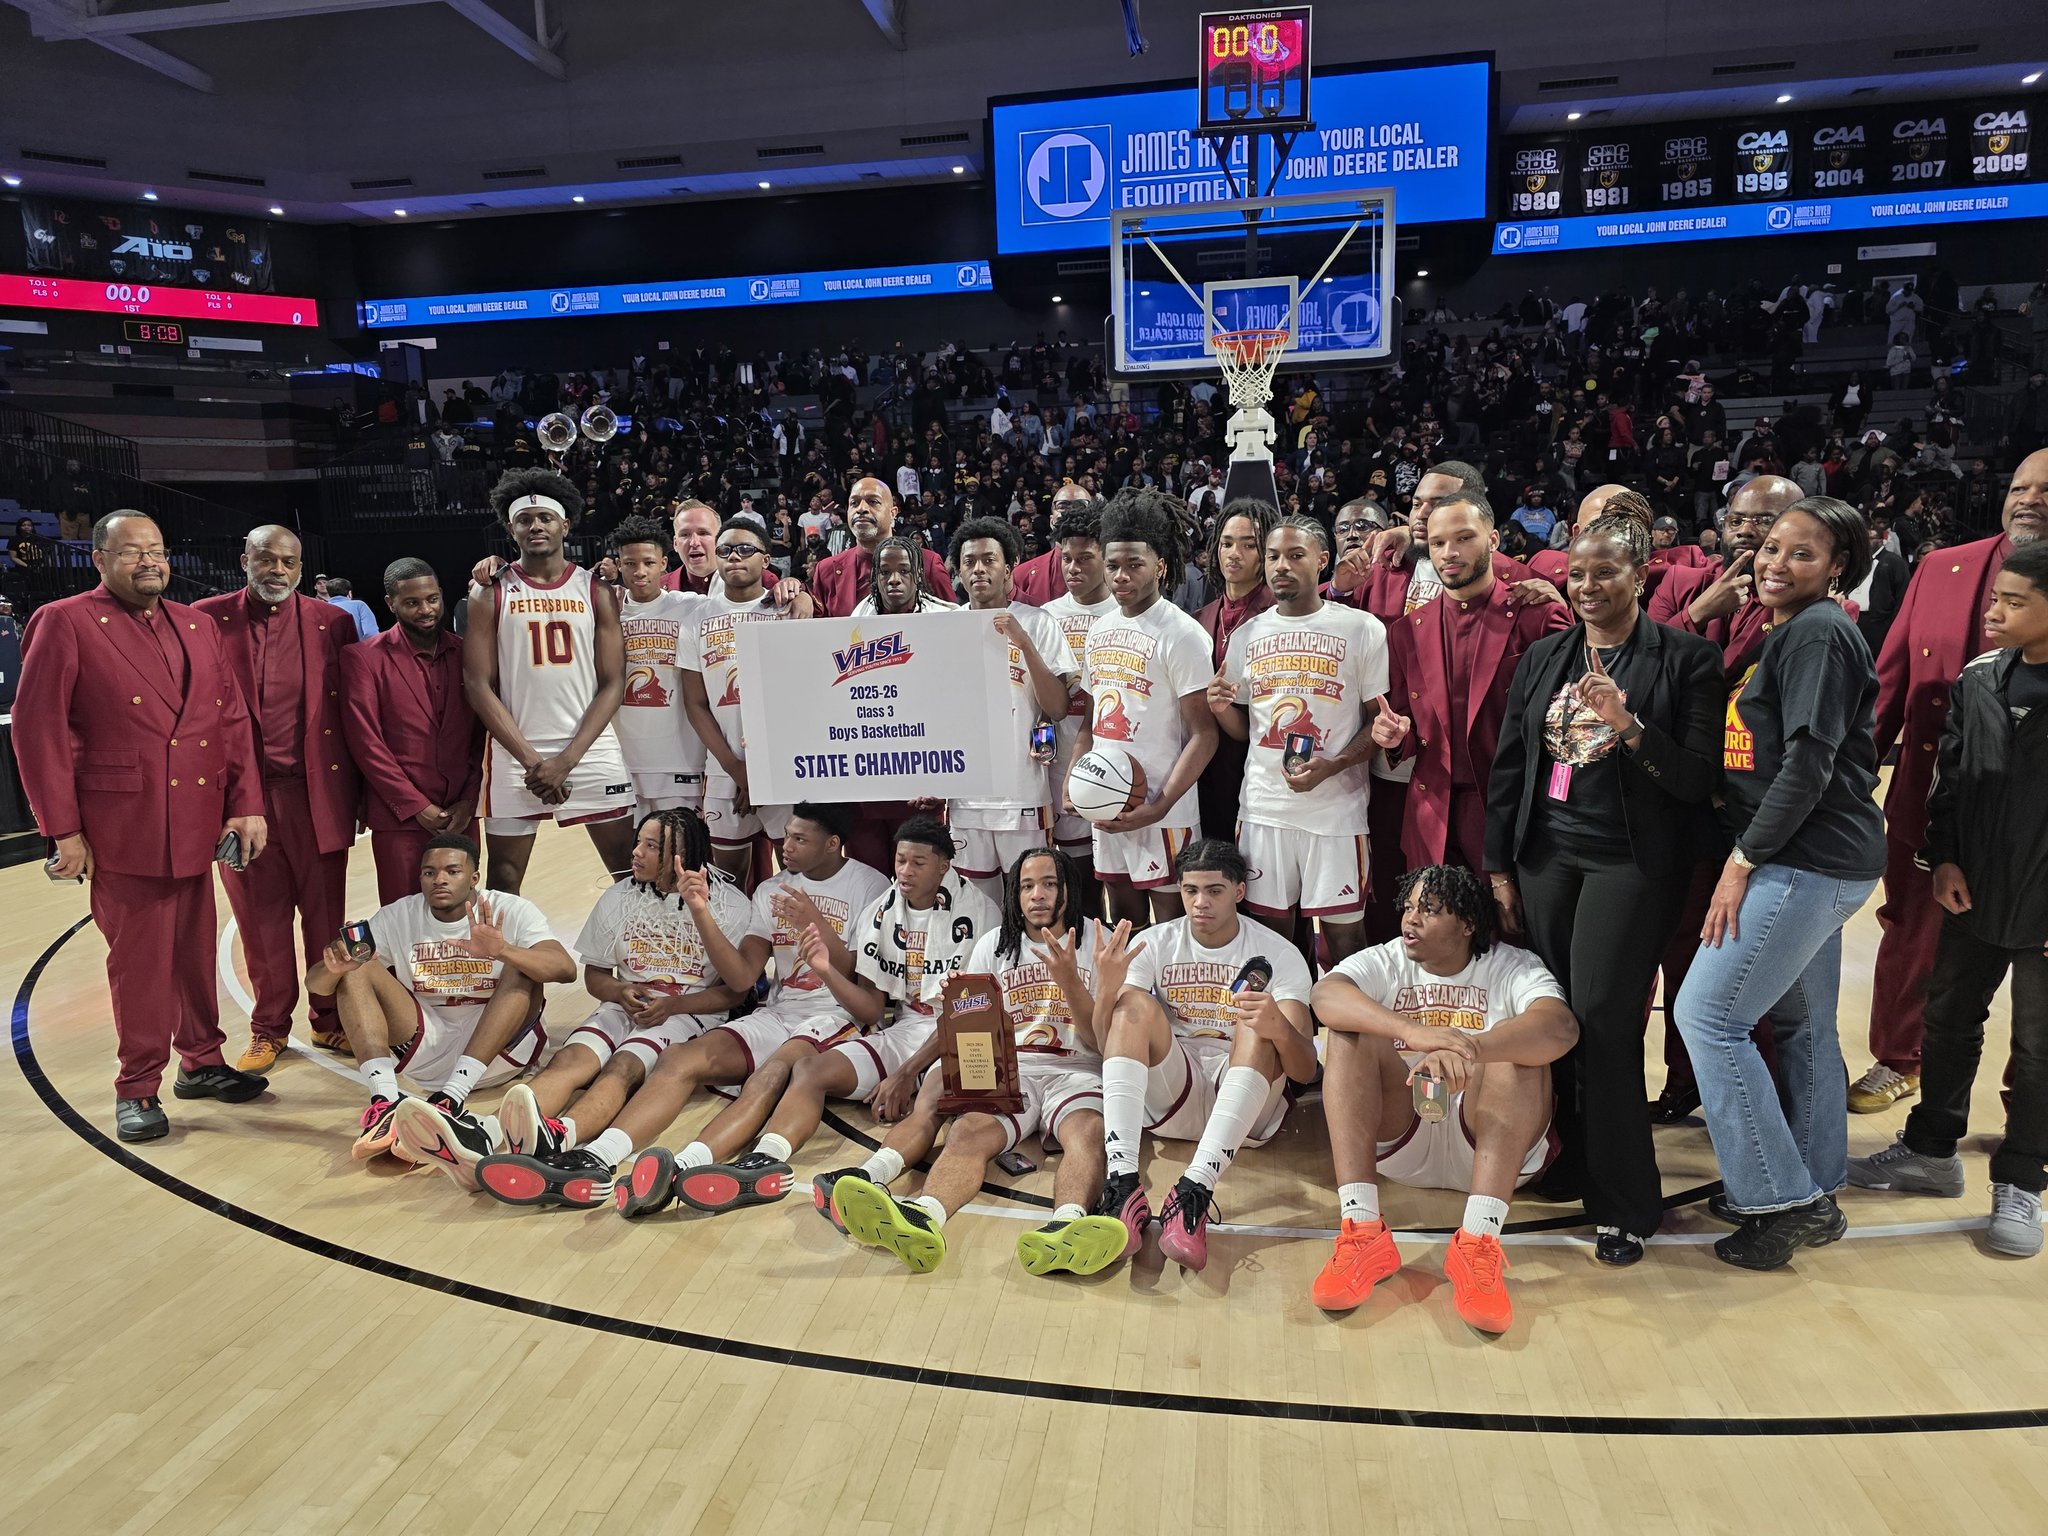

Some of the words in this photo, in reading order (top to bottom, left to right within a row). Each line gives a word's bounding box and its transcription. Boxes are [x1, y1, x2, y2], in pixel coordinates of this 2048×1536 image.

[1228, 11, 1282, 21] DAKTRONICS
[1892, 117, 1946, 138] CAA
[1973, 110, 2027, 130] CAA
[1320, 127, 1364, 151] YOUR
[1370, 122, 1424, 148] LOCAL
[1737, 129, 1789, 150] CAA
[1813, 125, 1865, 145] CAA
[1121, 129, 1191, 174] JAMES
[1588, 143, 1629, 167] SBC
[1665, 136, 1707, 160] SBC
[1285, 156, 1328, 180] JOHN
[1333, 151, 1388, 177] DEERE
[1393, 145, 1458, 172] DEALER
[1516, 148, 1556, 171] SBC
[1972, 153, 2028, 174] 2009
[1814, 168, 1864, 188] 2004
[1892, 160, 1946, 181] 2007
[1662, 177, 1712, 201] 1985
[1736, 171, 1788, 193] 1996
[1512, 191, 1560, 212] 1980
[1585, 186, 1629, 207] 1981
[1871, 205, 1894, 217] YOUR
[1895, 203, 1922, 216] LOCAL
[1923, 201, 1946, 213] JOHN
[1947, 199, 1975, 212] DEERE
[1975, 197, 2009, 210] DEALER
[1597, 225, 1618, 237] YOUR
[1619, 223, 1645, 235] LOCAL
[1646, 220, 1667, 233] JOHN
[1668, 219, 1694, 231] DEERE
[1695, 216, 1727, 229] DEALER
[823, 280, 842, 291] YOUR
[842, 279, 864, 289] LOCAL
[865, 277, 882, 288] JOHN
[883, 276, 905, 287] DEERE
[905, 274, 932, 285] DEALER
[105, 284, 150, 303] 00.0
[622, 293, 640, 303] YOUR
[640, 292, 661, 302] LOCAL
[662, 290, 679, 301] JOHN
[679, 289, 700, 300] DEERE
[700, 287, 726, 298] DEALER
[124, 304, 140, 312] 1ST
[208, 301, 221, 309] FLS
[428, 305, 445, 315] YOUR
[446, 304, 466, 314] LOCAL
[466, 303, 482, 313] JOHN
[483, 302, 503, 312] DEERE
[503, 300, 528, 311] DEALER
[292, 312, 302, 324] 0
[140, 324, 178, 341] 8:08
[510, 599, 585, 614] PETERSBURG
[627, 619, 680, 638] CHAMPIONS
[701, 613, 731, 638] STATE
[527, 619, 573, 667] 10
[832, 631, 910, 674] VHSL
[1088, 630, 1114, 655] STATE
[1114, 628, 1158, 660] CHAMPIONS
[1246, 634, 1278, 664] STATE
[1278, 631, 1346, 661] CHAMPIONS
[708, 655, 717, 664] 20
[1089, 648, 1146, 675] PETERSBURG
[1250, 654, 1338, 678] PETERSBURG
[1010, 669, 1020, 680] 26
[1260, 675, 1298, 689] Crimson
[1297, 672, 1325, 688] Wave
[850, 684, 898, 700] 2025-26
[1136, 679, 1147, 692] 26
[1252, 684, 1262, 696] 20
[1325, 683, 1338, 696] 26
[856, 706, 885, 718] Class
[887, 705, 894, 717] 3
[829, 725, 859, 742] Boys
[861, 723, 925, 739] Basketball
[794, 754, 849, 779] STATE
[854, 750, 966, 776] CHAMPIONS
[774, 935, 785, 944] 20
[411, 942, 440, 963] STATE
[414, 960, 493, 977] PETERSBURG
[1002, 963, 1034, 992] STATE
[1161, 962, 1197, 988] STATE
[425, 975, 462, 989] Crimson
[482, 979, 494, 989] 26
[953, 993, 989, 1012] VHSL
[1178, 1003, 1217, 1019] Crimson
[1012, 1011, 1024, 1023] 20
